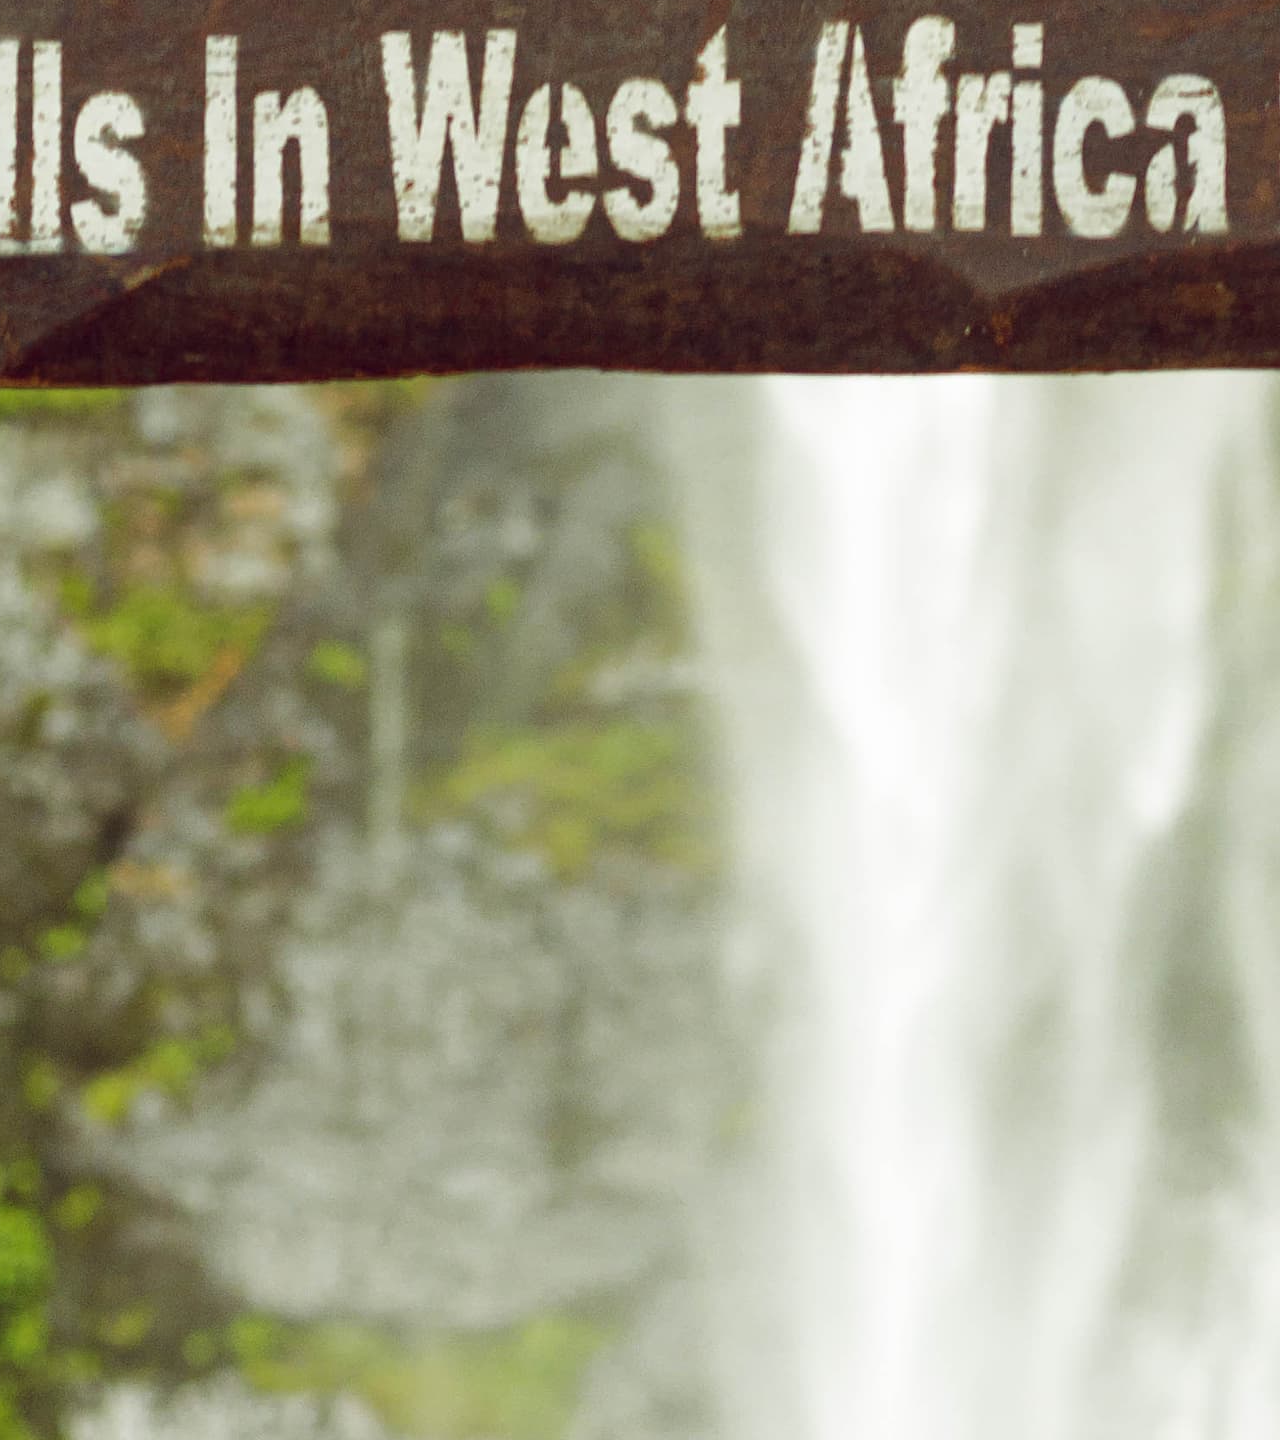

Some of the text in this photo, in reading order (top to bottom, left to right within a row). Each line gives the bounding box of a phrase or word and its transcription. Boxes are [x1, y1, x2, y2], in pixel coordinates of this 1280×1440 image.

[203, 35, 330, 246] In
[380, 26, 741, 242] West
[788, 16, 1227, 237] Africa
